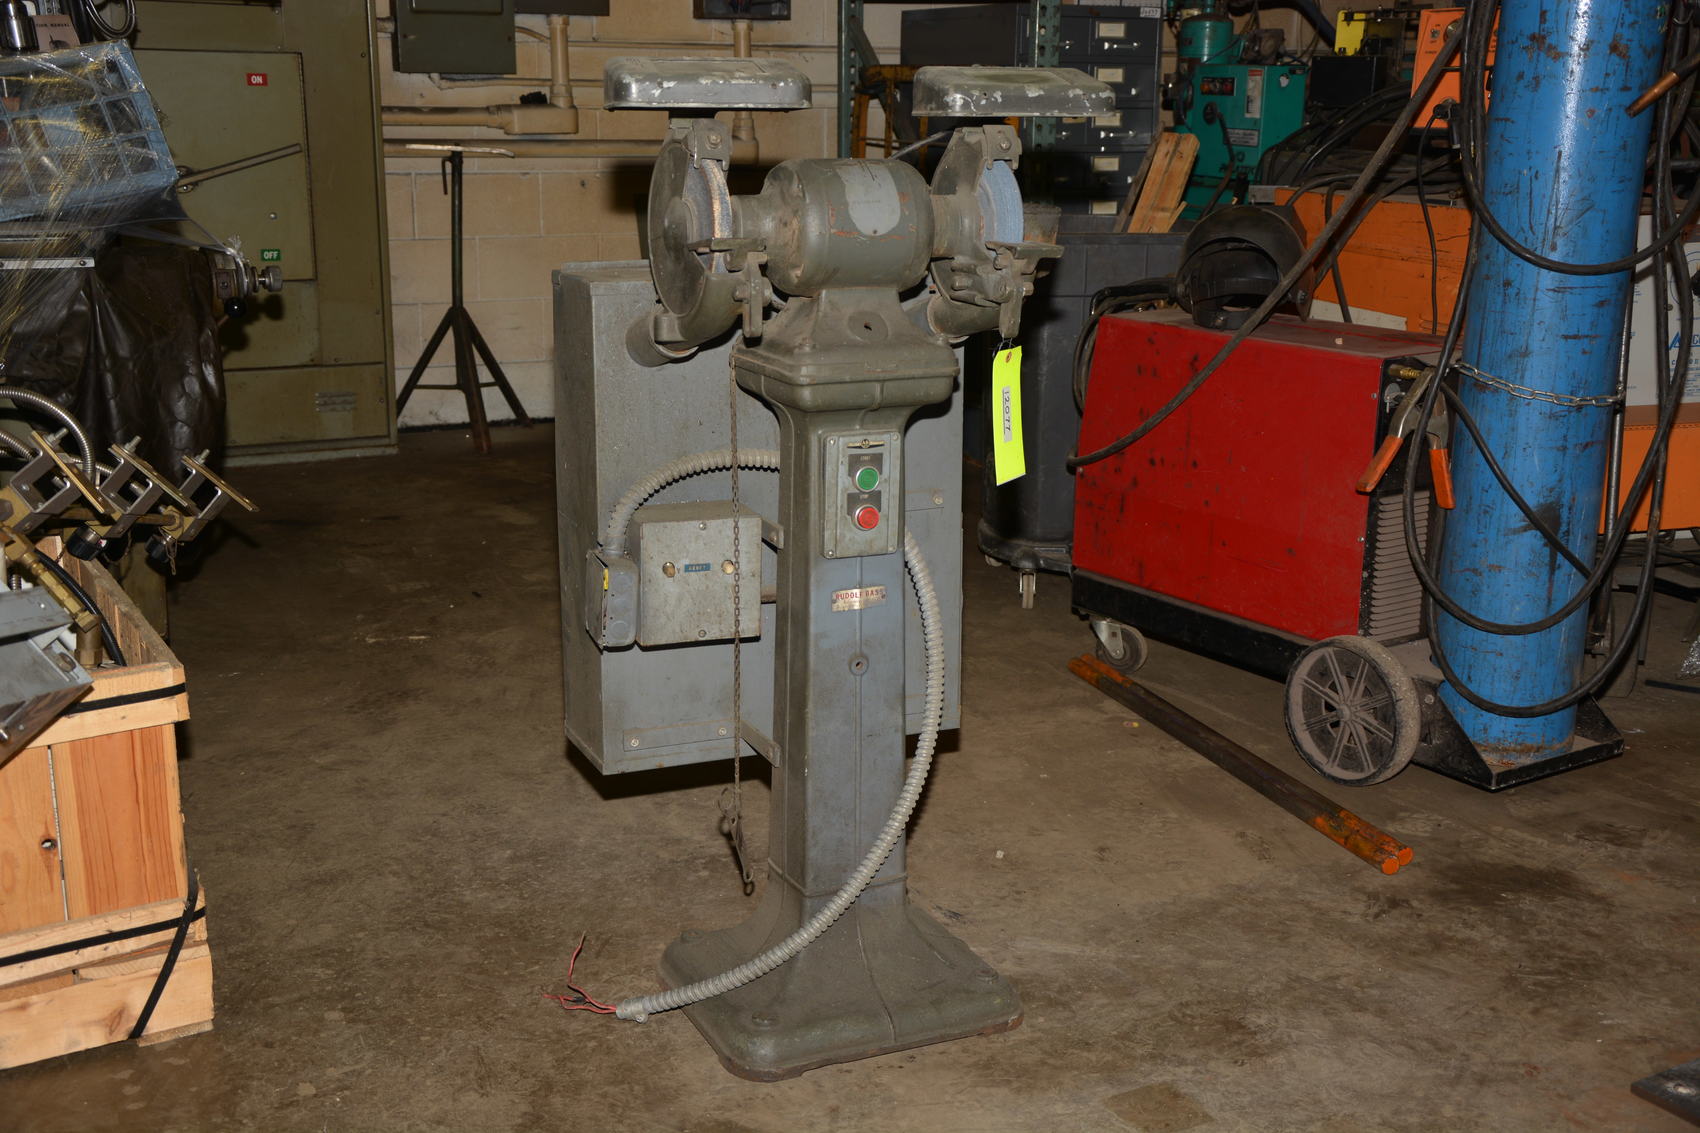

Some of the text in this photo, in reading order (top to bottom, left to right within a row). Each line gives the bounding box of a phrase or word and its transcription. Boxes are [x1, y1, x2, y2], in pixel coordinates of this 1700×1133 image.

[251, 75, 263, 84] ON
[263, 251, 278, 259] OFF
[835, 588, 883, 600] RUDOLF BASS
